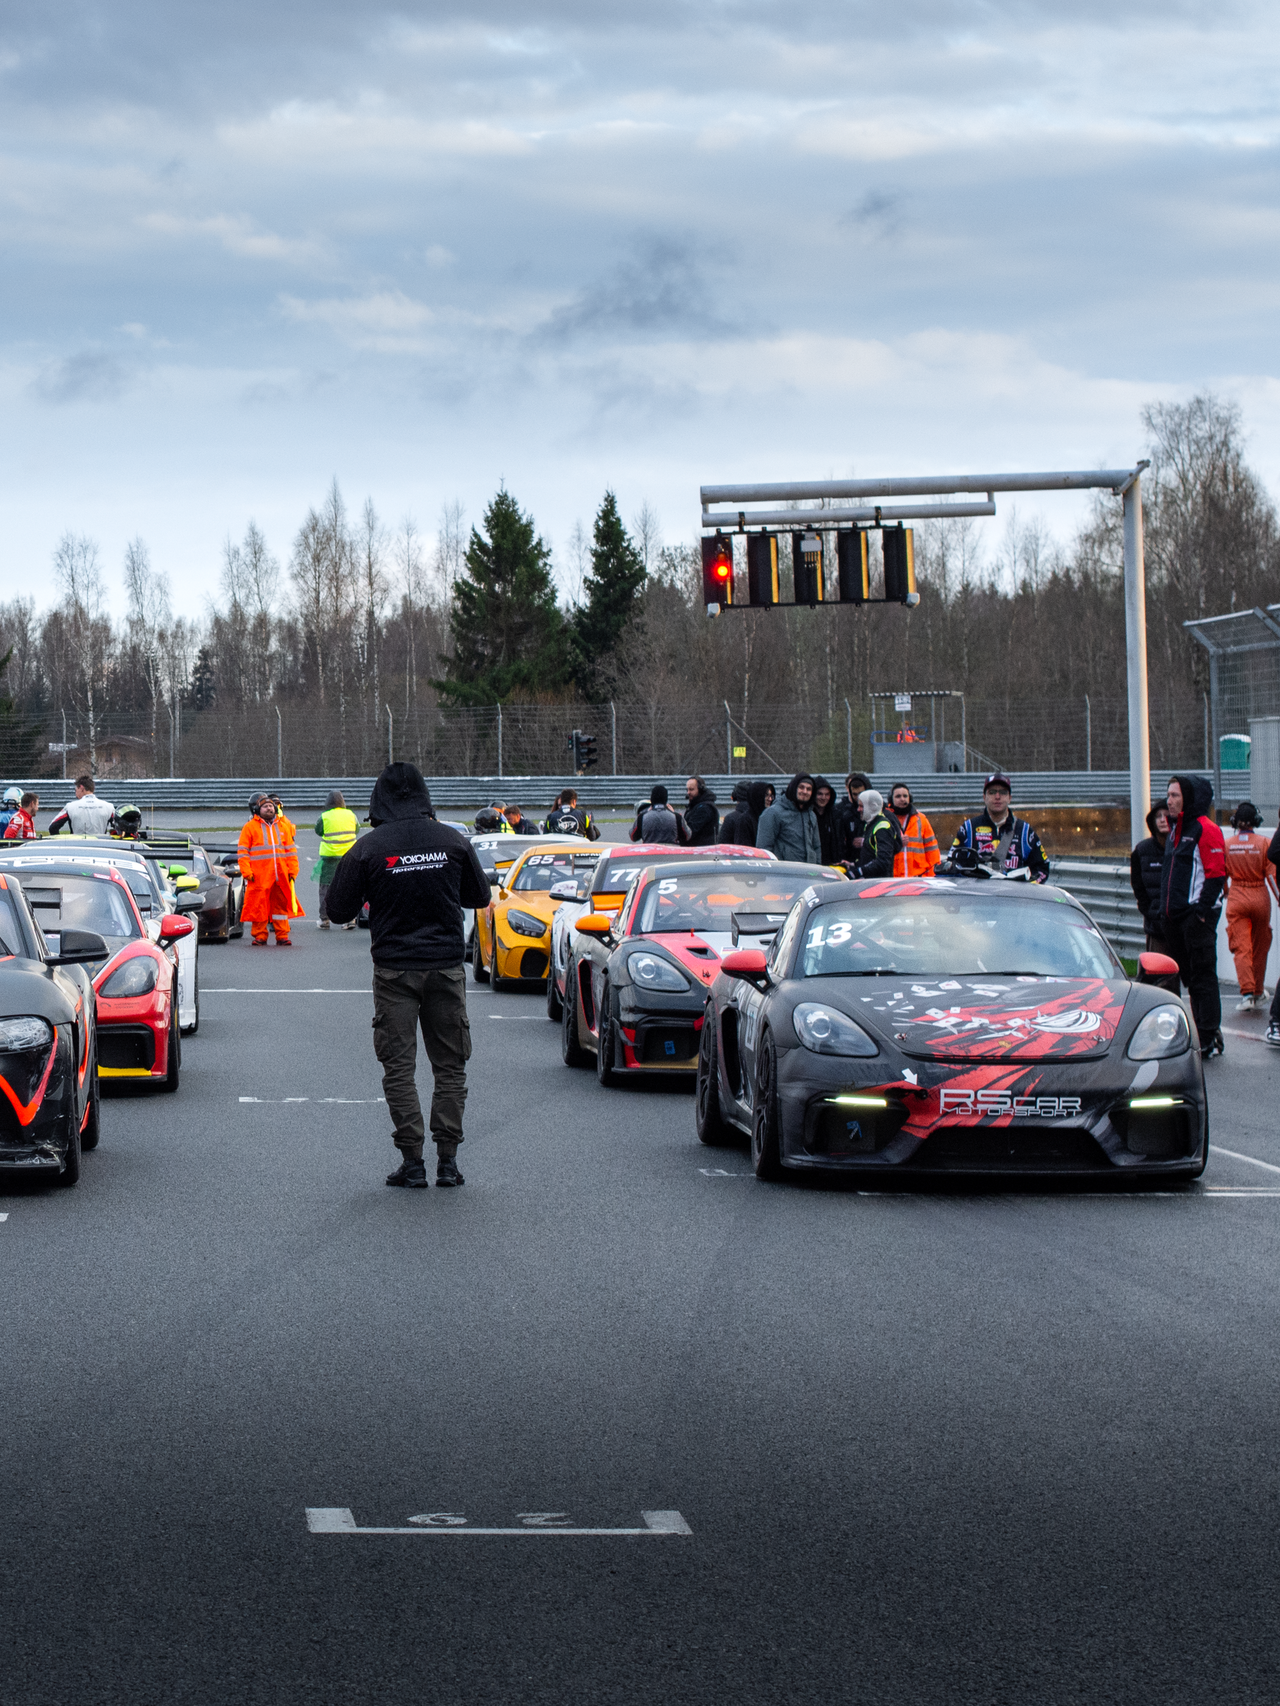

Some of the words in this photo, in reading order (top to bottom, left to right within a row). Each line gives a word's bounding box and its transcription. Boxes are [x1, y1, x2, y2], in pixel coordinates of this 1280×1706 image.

[478, 841, 498, 850] 31
[399, 852, 448, 865] YOKOHAMA
[528, 855, 555, 865] 65
[1005, 856, 1019, 868] ull
[610, 868, 641, 883] 77
[657, 878, 678, 895] 5
[806, 922, 852, 948] 13
[940, 1107, 1081, 1117] MOTORSPORT
